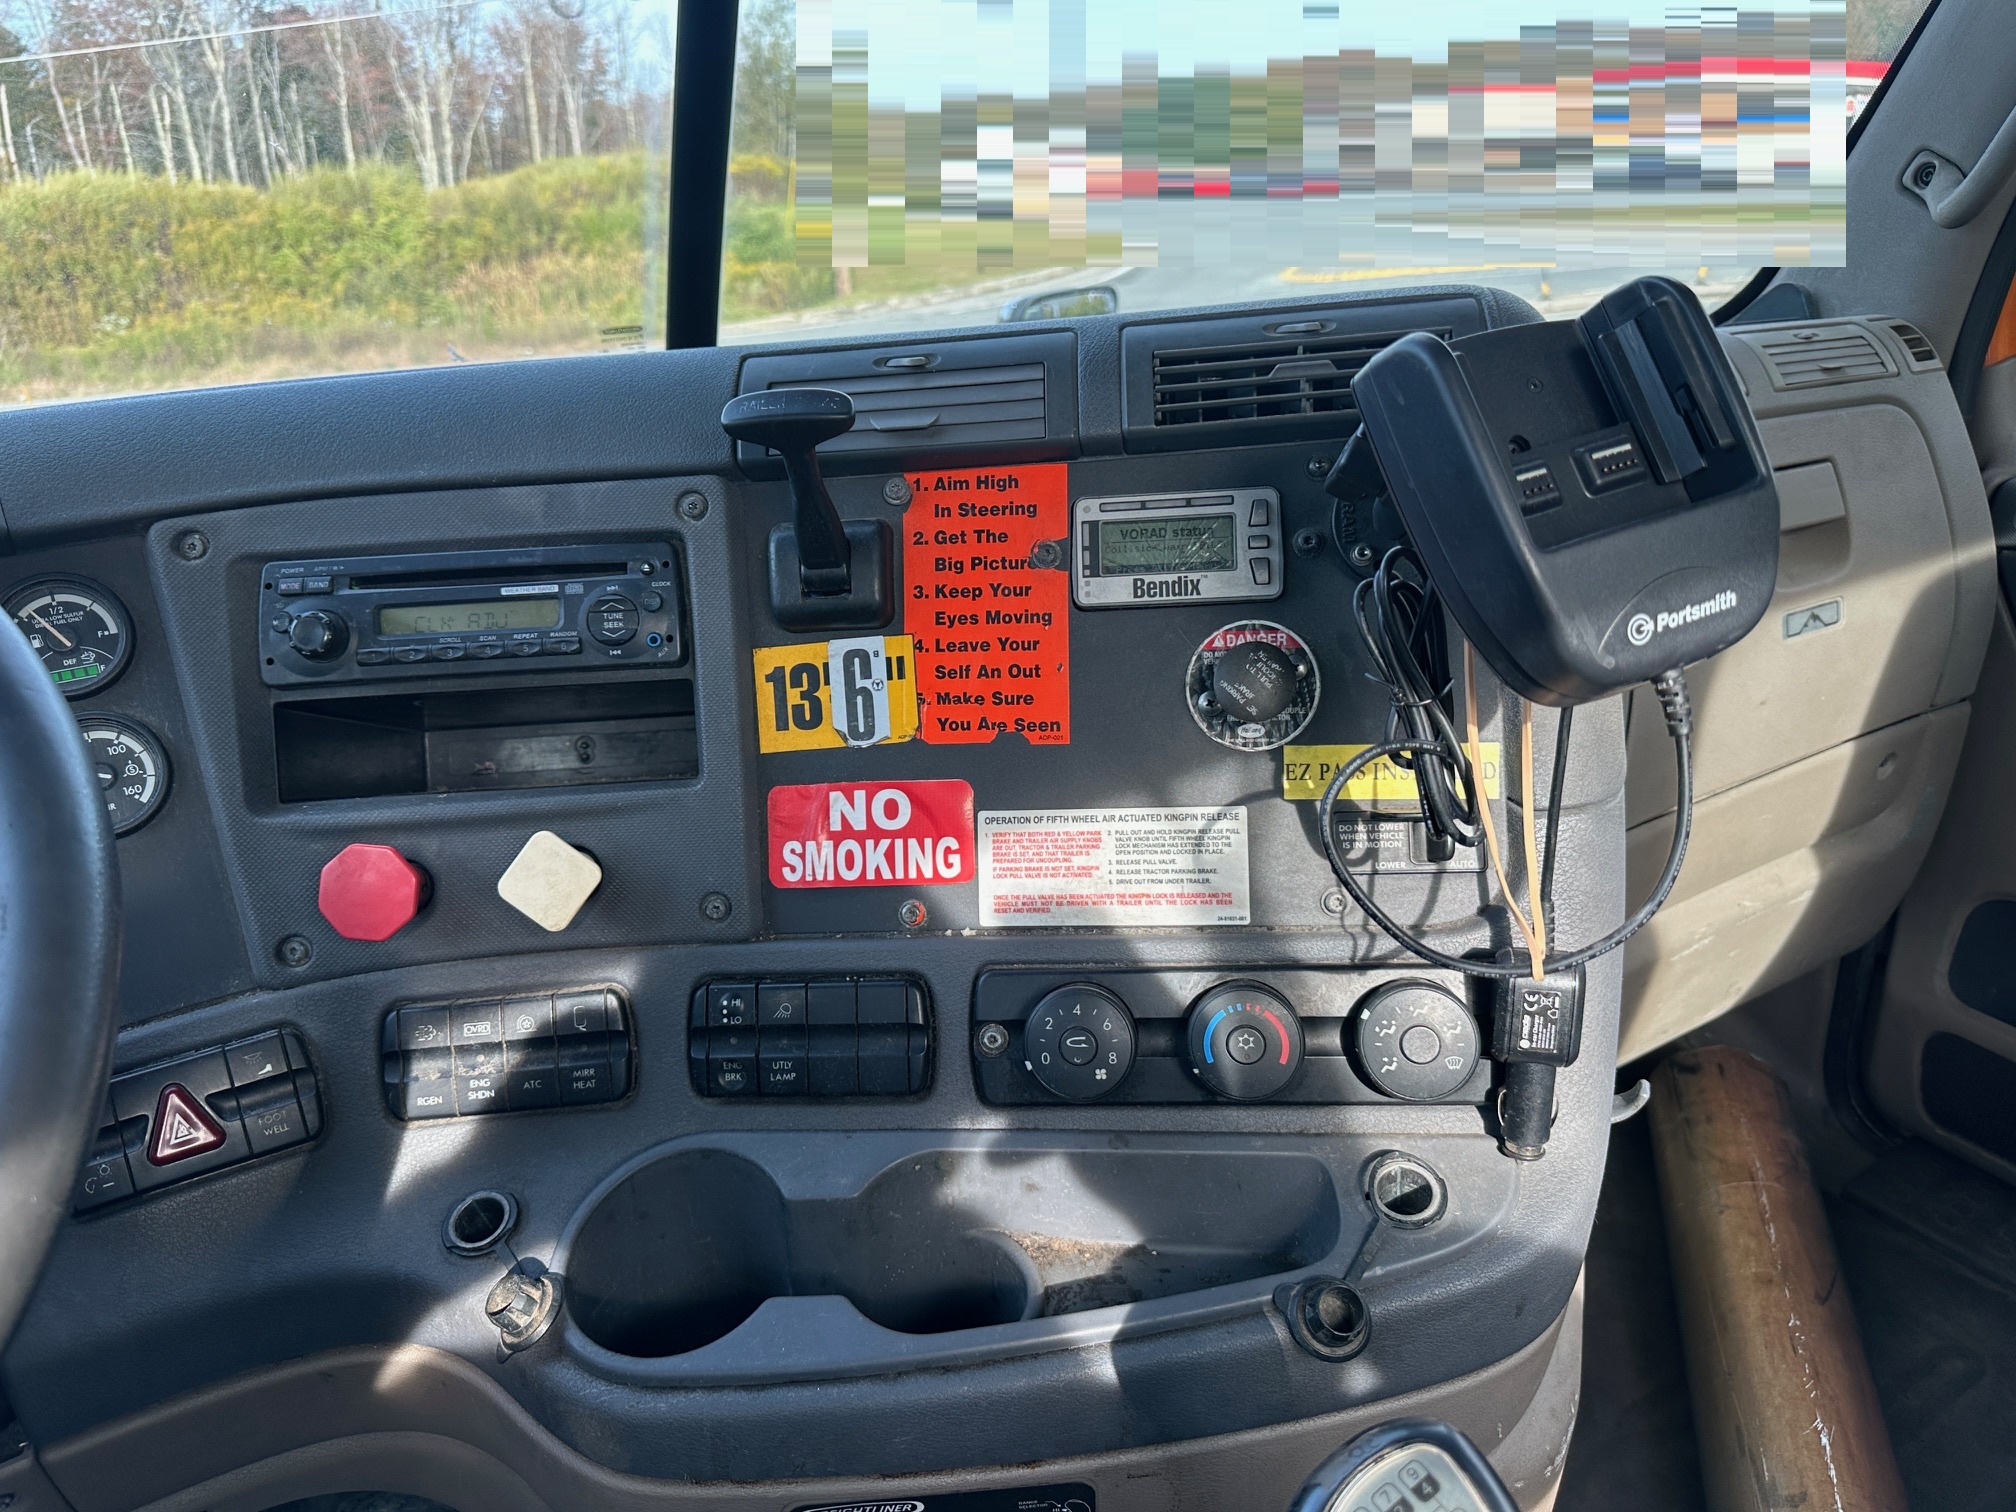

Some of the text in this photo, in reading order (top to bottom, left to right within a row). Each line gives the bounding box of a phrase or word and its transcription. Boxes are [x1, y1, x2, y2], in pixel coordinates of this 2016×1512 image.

[913, 475, 1018, 492] 1. Aim High
[934, 501, 1037, 518] In Steering
[913, 530, 1008, 545] 2. Get The
[1120, 528, 1167, 540] VORAD
[935, 557, 964, 574] Big
[280, 582, 300, 590] MODE
[913, 583, 1032, 601] 3. Keep Your
[1133, 577, 1201, 598] Bendix
[49, 606, 64, 614] 1/2
[1657, 590, 1736, 632] Portsmith
[935, 610, 1052, 628] Eyes Moving
[914, 637, 1039, 653] 4. Leave Your
[1226, 633, 1287, 647] DANGER
[658, 646, 669, 658] AUX
[935, 664, 1041, 679] Self An Out
[936, 692, 985, 705] Make
[992, 692, 1034, 705] Sure
[937, 717, 1060, 732] You Are Seen
[107, 744, 126, 755] 100
[1285, 764, 1311, 780] EZ
[123, 784, 142, 795] 160
[829, 788, 912, 831] NO
[985, 816, 1031, 825] OPERATION
[1033, 816, 1044, 824] OF
[1071, 815, 1100, 823] WHEEL
[1102, 814, 1116, 822] AIR
[1118, 814, 1162, 822] ACTUATED
[1164, 813, 1198, 821] KINGPIN
[1201, 812, 1240, 821] RELEASE
[782, 836, 961, 882] SMOKING
[1450, 860, 1475, 868] AUTO
[1072, 1004, 1081, 1015] 4
[466, 1024, 489, 1033] OVRD
[1045, 1018, 1053, 1029] 2
[1103, 1018, 1111, 1030] 6
[1041, 1052, 1050, 1064] 0
[1109, 1052, 1117, 1064] 8
[773, 1061, 792, 1069] UTLY
[771, 1073, 796, 1081] LAMP
[470, 1079, 490, 1088] ENG
[524, 1080, 542, 1088] ATC
[574, 1080, 595, 1088] HEAT
[417, 1096, 442, 1105] RGEN
[468, 1090, 494, 1100] SHDN
[258, 1111, 287, 1126] FOOT
[263, 1123, 290, 1136] WELL
[1406, 1467, 1419, 1480] 9
[1379, 1489, 1392, 1501] 7
[1421, 1483, 1432, 1495] 4
